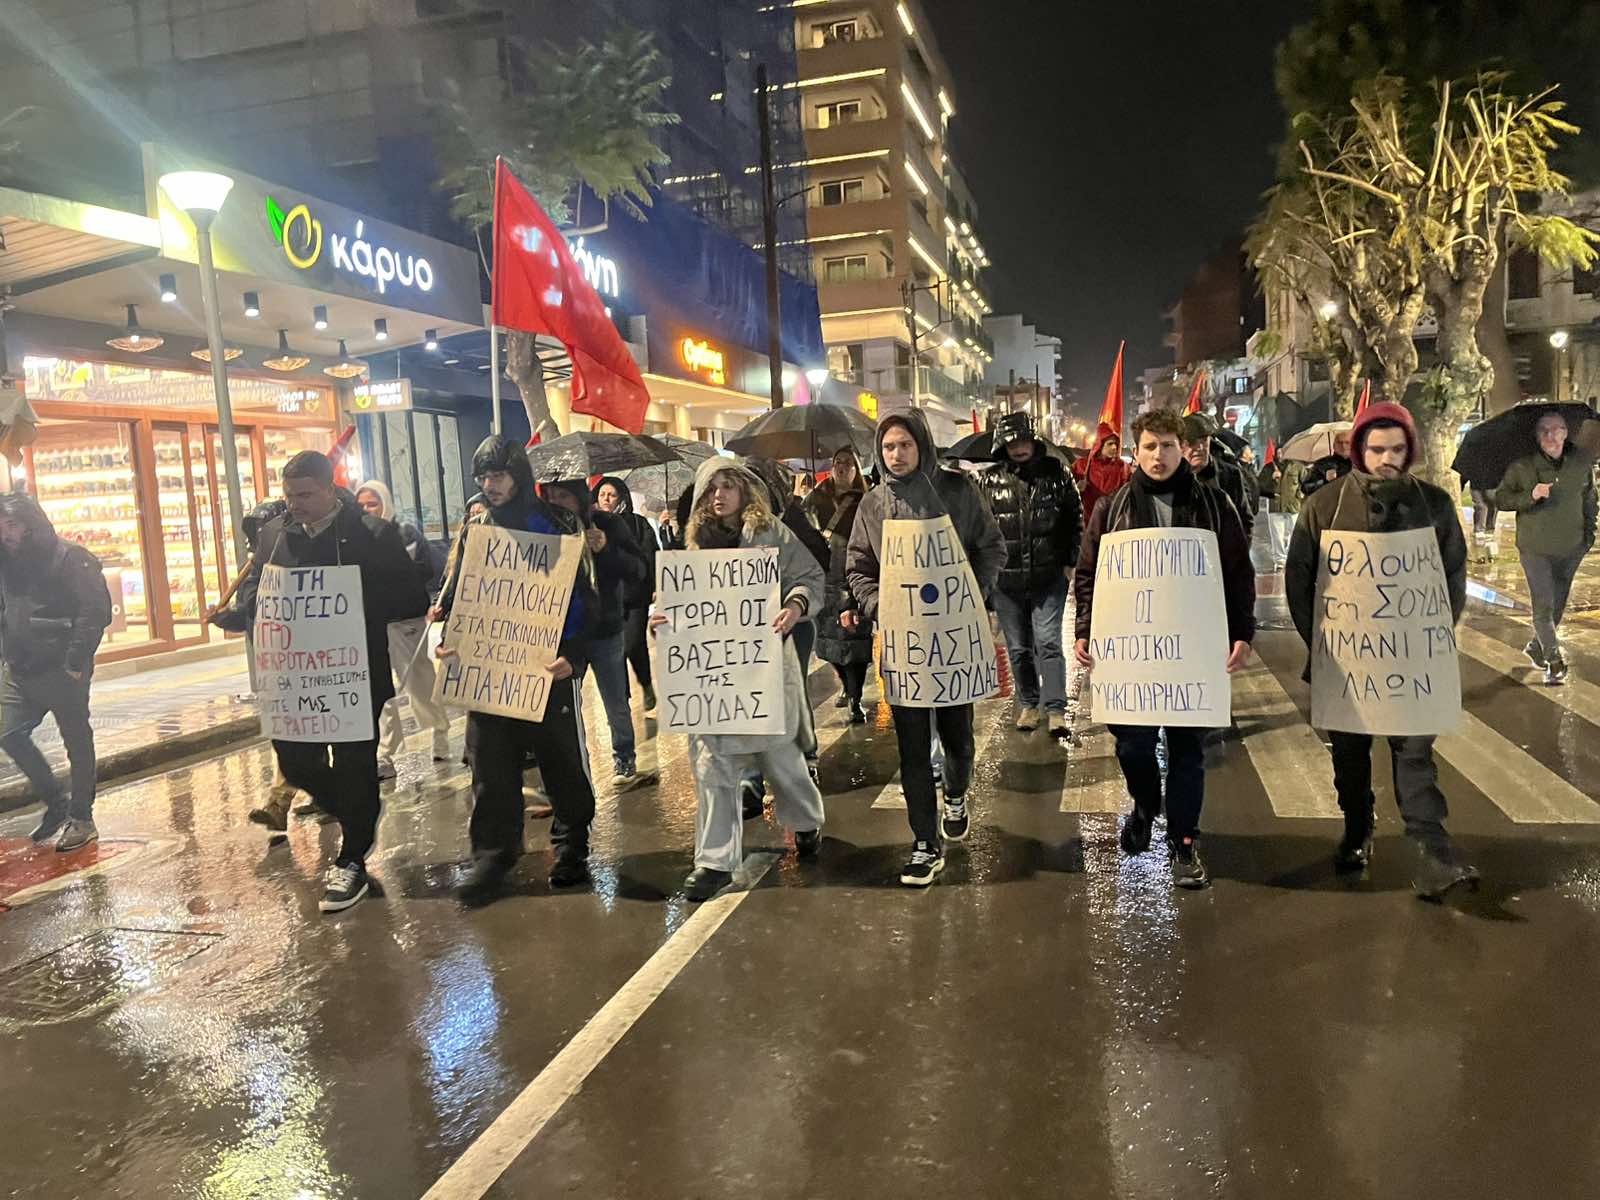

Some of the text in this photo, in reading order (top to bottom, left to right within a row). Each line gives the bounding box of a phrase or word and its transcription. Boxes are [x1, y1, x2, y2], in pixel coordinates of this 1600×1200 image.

[331, 219, 434, 294] κάρυο
[485, 538, 549, 576] ΚΑΜΙΑ
[886, 536, 904, 566] ΝΑ
[291, 570, 324, 592] ΤΗ
[661, 555, 779, 592] ΝΑ ΚΛΕΙΣΟΥΝ
[256, 593, 348, 622] ΜΕΣΟΓΕΙΟ
[460, 574, 567, 617] ΕΜΠΛΟΚΗ
[1135, 589, 1154, 624] ΟΙ
[1321, 595, 1359, 622] τη
[452, 614, 559, 649] ΣΤΑ ΕΠΙΚΙΝΔΥΝΑ
[664, 598, 767, 633] ΤΩΡΑ ΟΙ
[473, 640, 528, 665] ΣΧΕΔΙΑ
[667, 639, 769, 674] ΒΑΣΕΙΣ
[884, 621, 984, 668] Η ΒΑΣΗ
[1091, 634, 1184, 661] ΝΑΤΟΙΚΟΙ
[1319, 624, 1457, 660] ΛΙΜΑΝΙ ΤΩΝ
[442, 664, 546, 713] ΗΠΑ-ΝΑΤΟ
[696, 673, 735, 688] ΤΗΣ
[884, 659, 998, 703] ΤΗΣ ΣΟΥΔΑΣ
[1342, 671, 1432, 701] ΛΑΩΝ
[298, 695, 331, 713] ΜΑΣ
[338, 692, 359, 708] ΤΟ
[667, 691, 768, 727] ΣΟΥΔΑΣ
